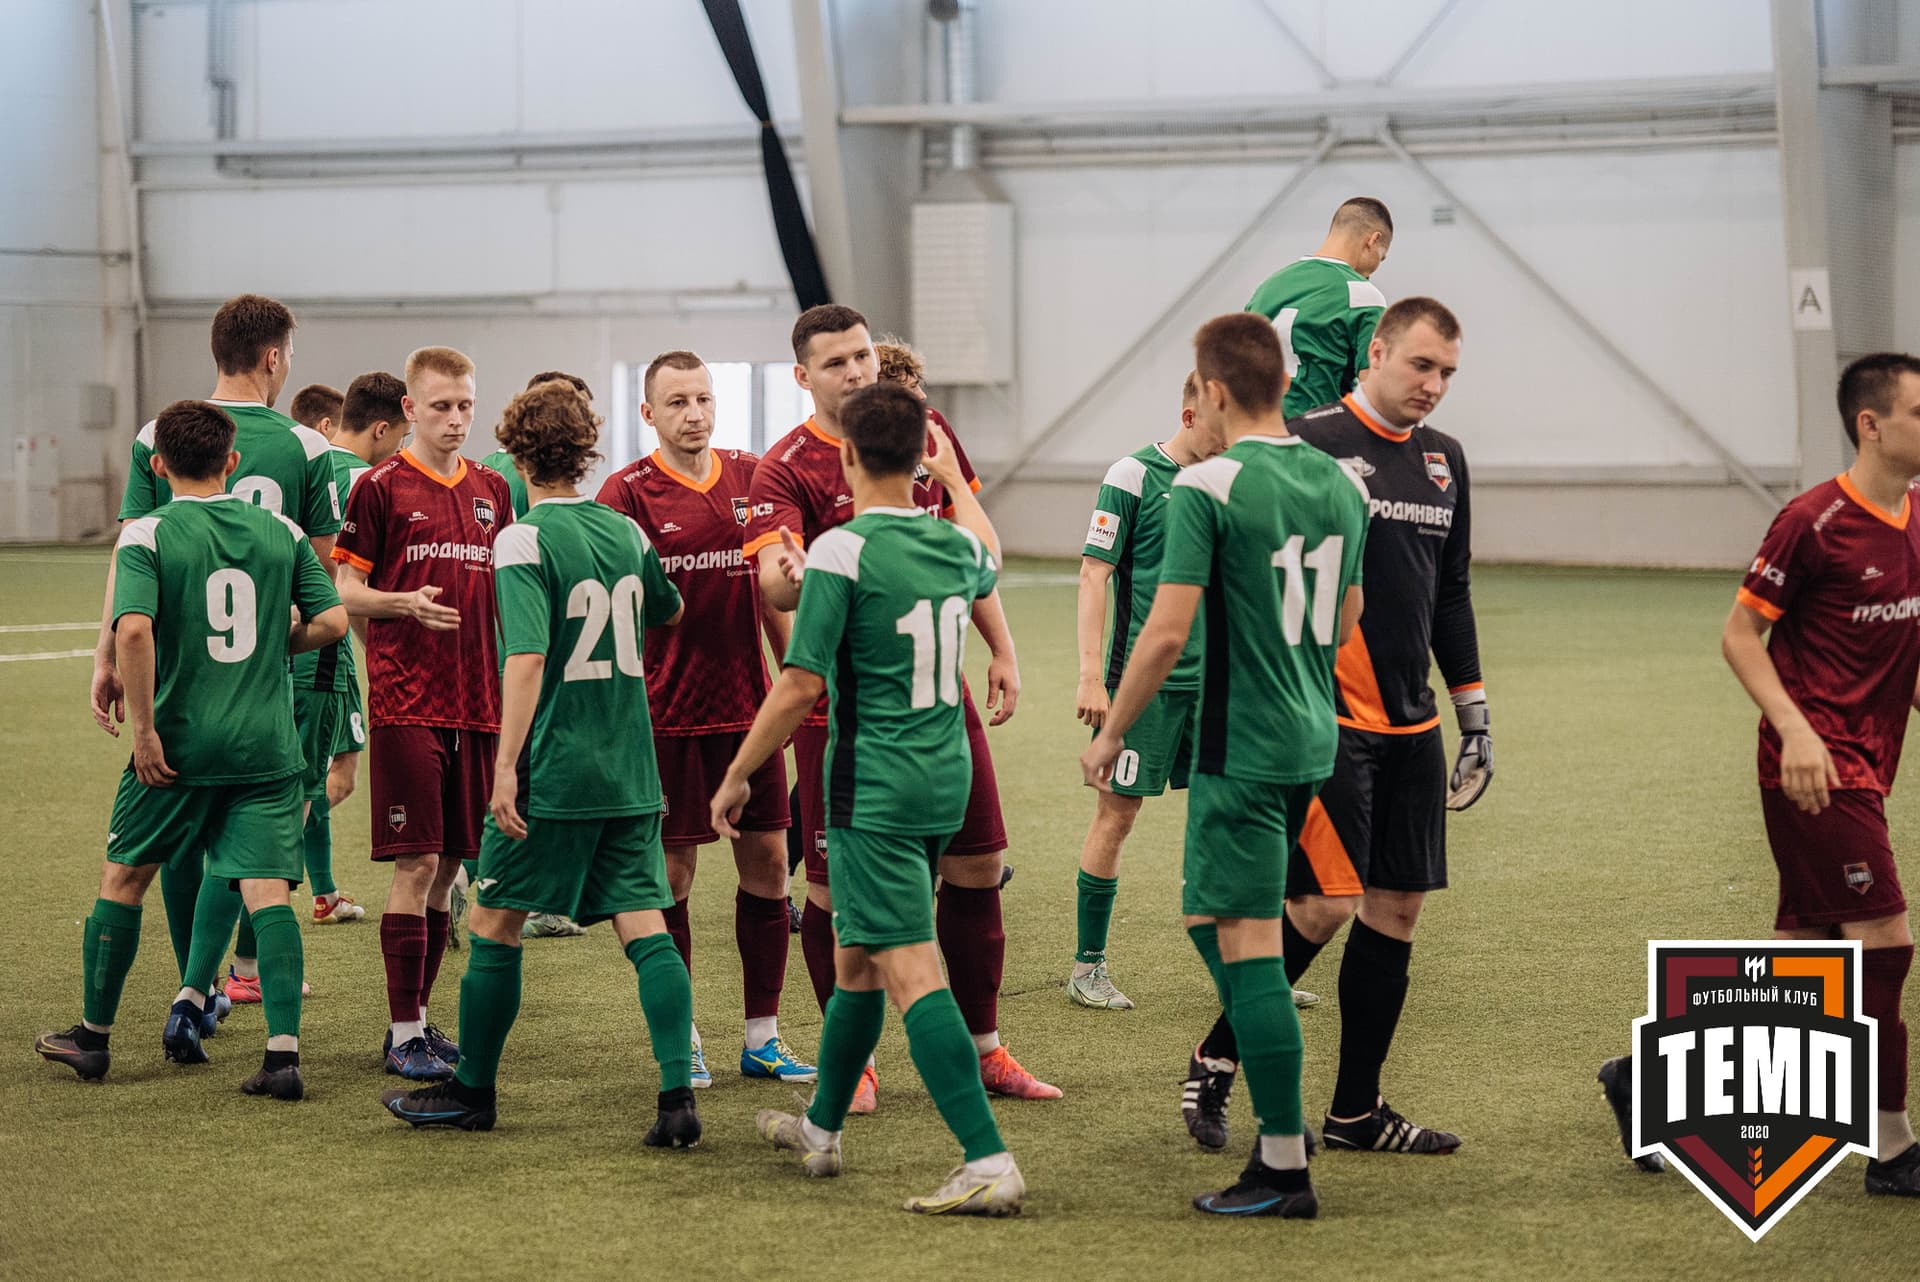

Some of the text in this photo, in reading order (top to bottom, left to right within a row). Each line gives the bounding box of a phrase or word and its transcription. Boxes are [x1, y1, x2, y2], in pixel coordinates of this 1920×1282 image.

[660, 548, 750, 574] ПРОДИНВ
[1270, 534, 1344, 646] 11
[206, 568, 257, 663] 9
[564, 574, 644, 682] 20
[896, 595, 969, 709] 10
[350, 711, 366, 744] 8
